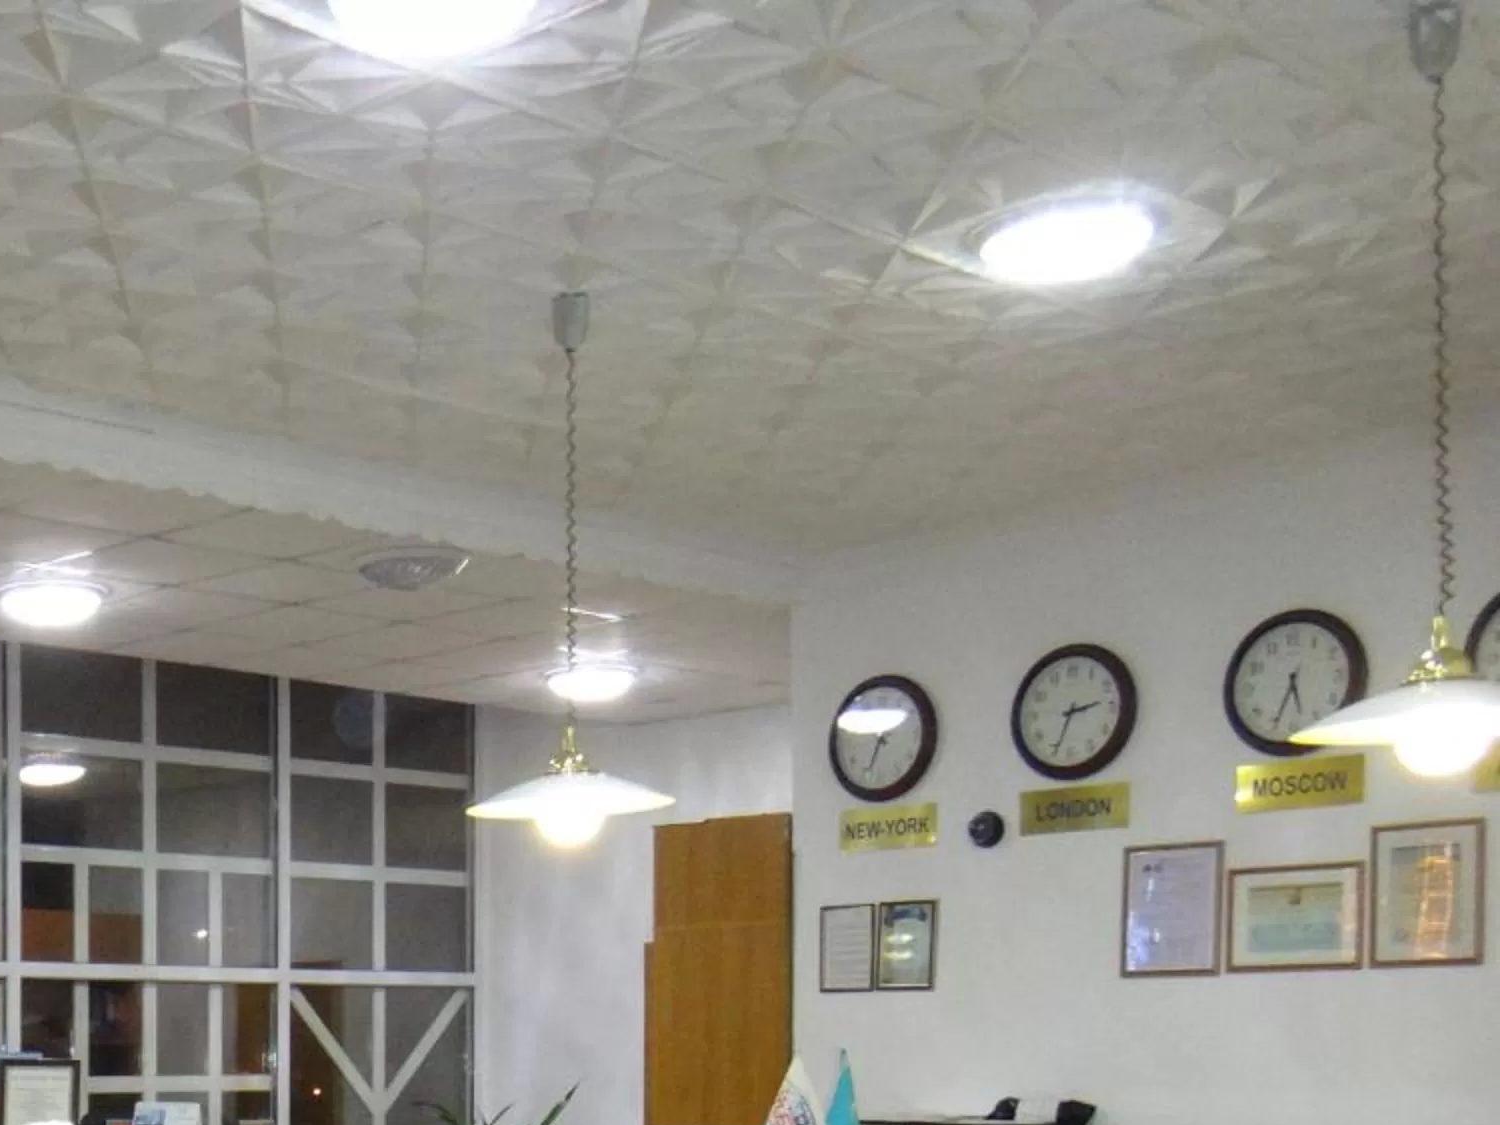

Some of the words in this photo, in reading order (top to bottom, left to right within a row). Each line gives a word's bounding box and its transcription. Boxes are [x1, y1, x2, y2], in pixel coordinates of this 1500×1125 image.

[1252, 771, 1348, 797] MOSCOW
[1035, 797, 1112, 823] LONDON
[845, 817, 930, 840] NEW-YORK
